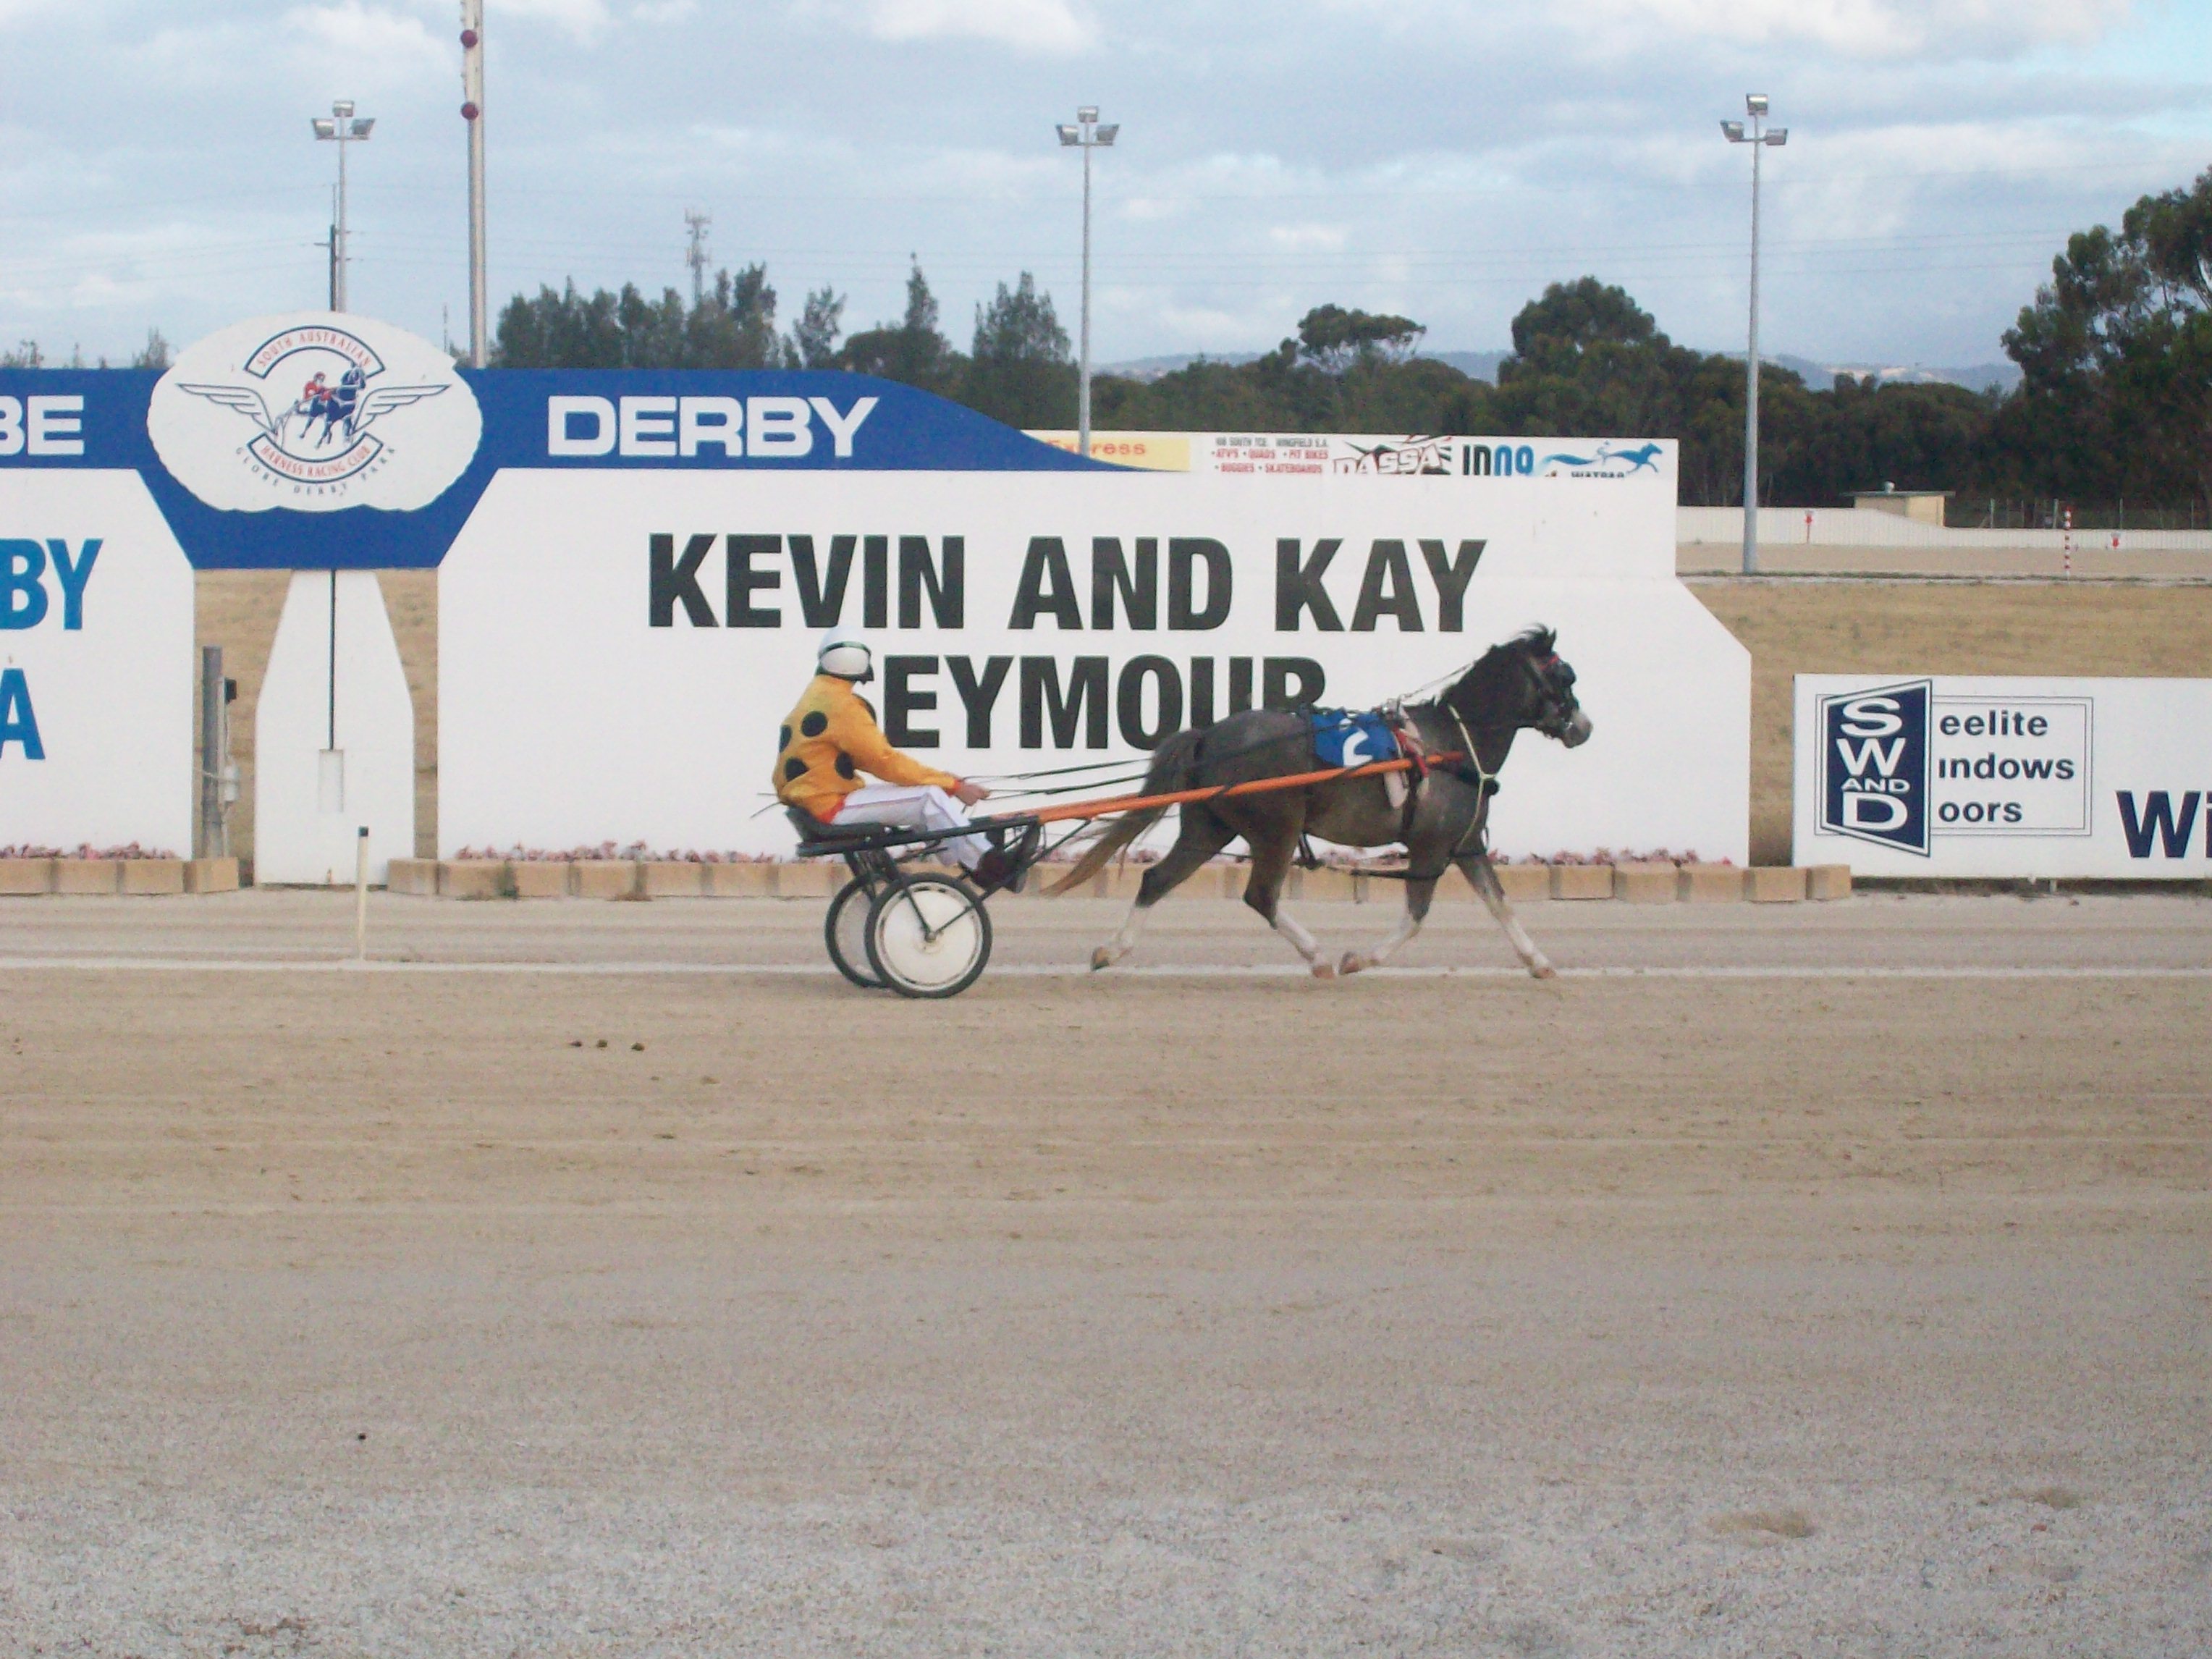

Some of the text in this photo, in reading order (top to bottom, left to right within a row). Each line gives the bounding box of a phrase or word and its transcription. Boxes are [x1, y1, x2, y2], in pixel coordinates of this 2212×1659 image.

[256, 331, 372, 367] SOUTH AUSTRALIAN
[548, 395, 879, 457] DERBY
[259, 445, 371, 477] HARNESS RACING CLUB
[649, 533, 1487, 634] KEVIN AND KAY
[858, 654, 1327, 751] EYMOUR
[1939, 709, 2048, 737] eelite
[1338, 717, 1374, 767] 2
[1841, 778, 1911, 793] AND
[1938, 801, 2023, 824] oors
